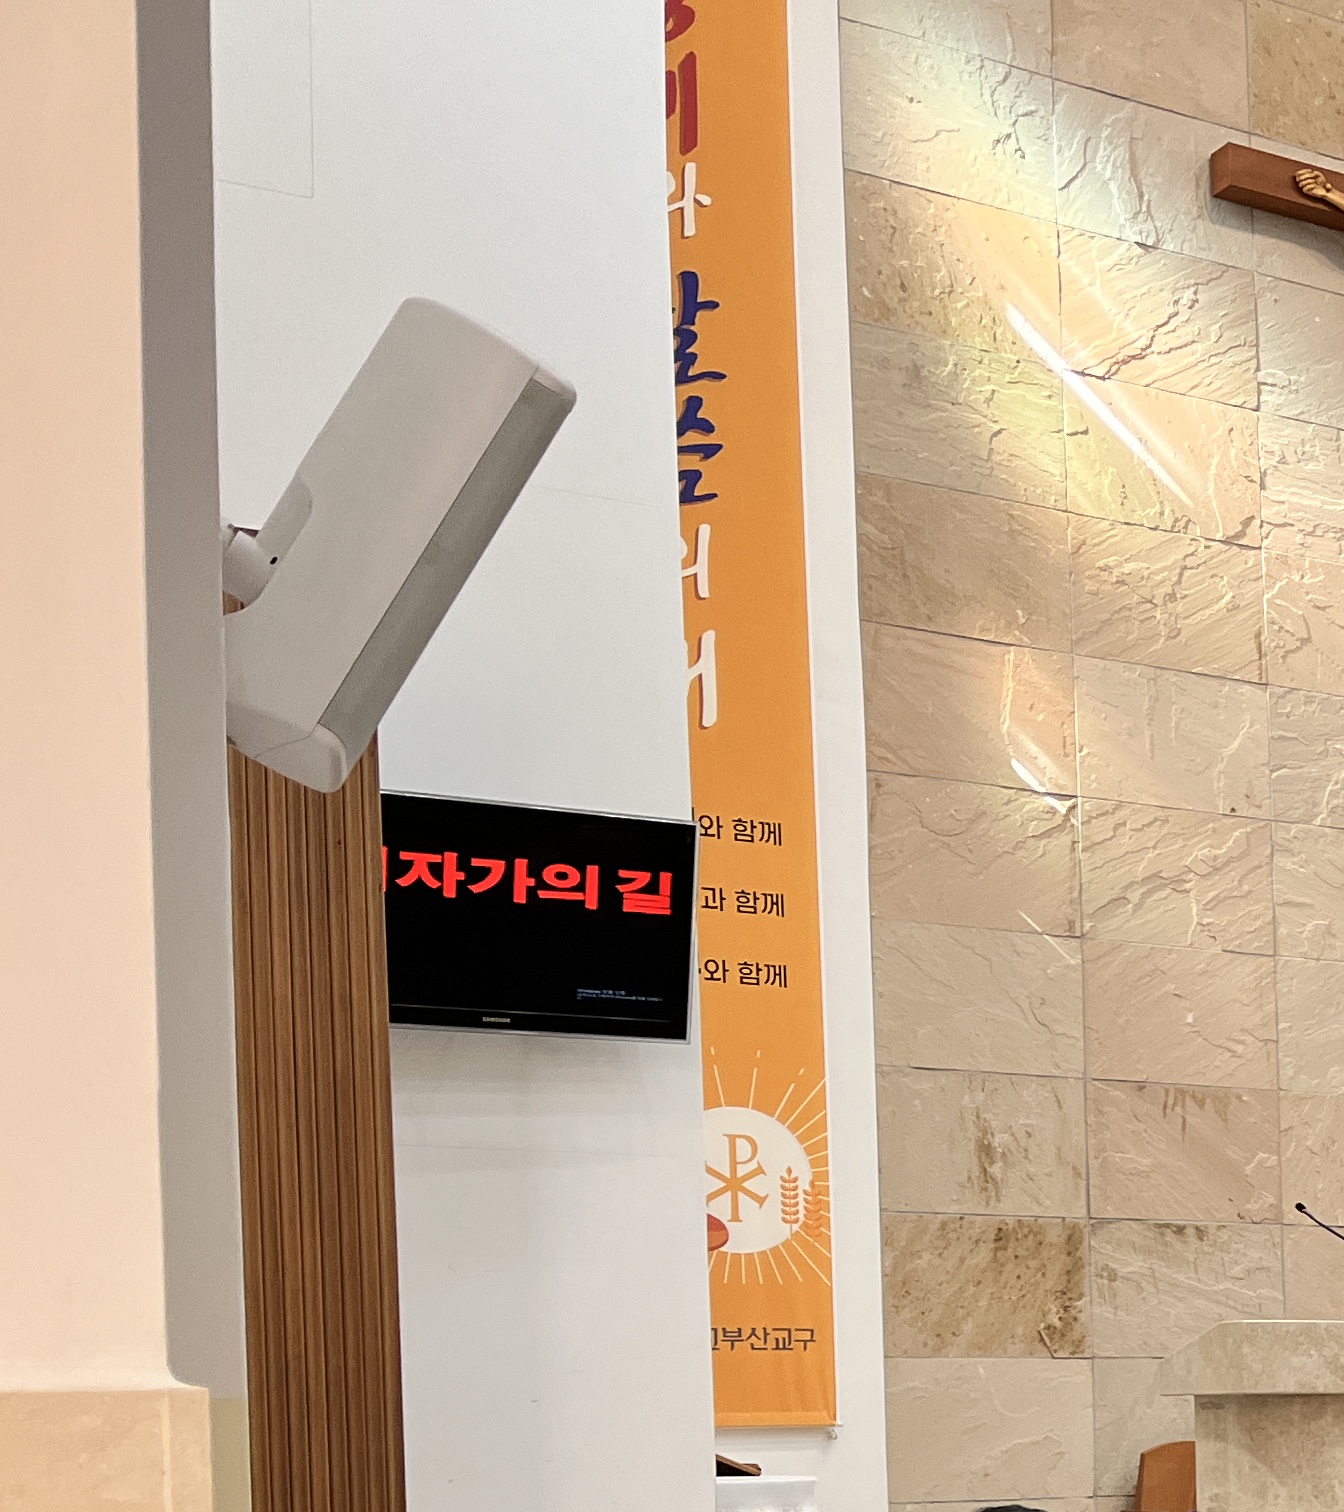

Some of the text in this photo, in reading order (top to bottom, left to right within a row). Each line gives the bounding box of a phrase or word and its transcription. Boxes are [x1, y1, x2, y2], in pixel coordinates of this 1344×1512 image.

[731, 817, 782, 847] 함께
[381, 845, 673, 916] 자가의 길
[734, 888, 785, 918] 함께
[698, 958, 788, 989] 와 함께
